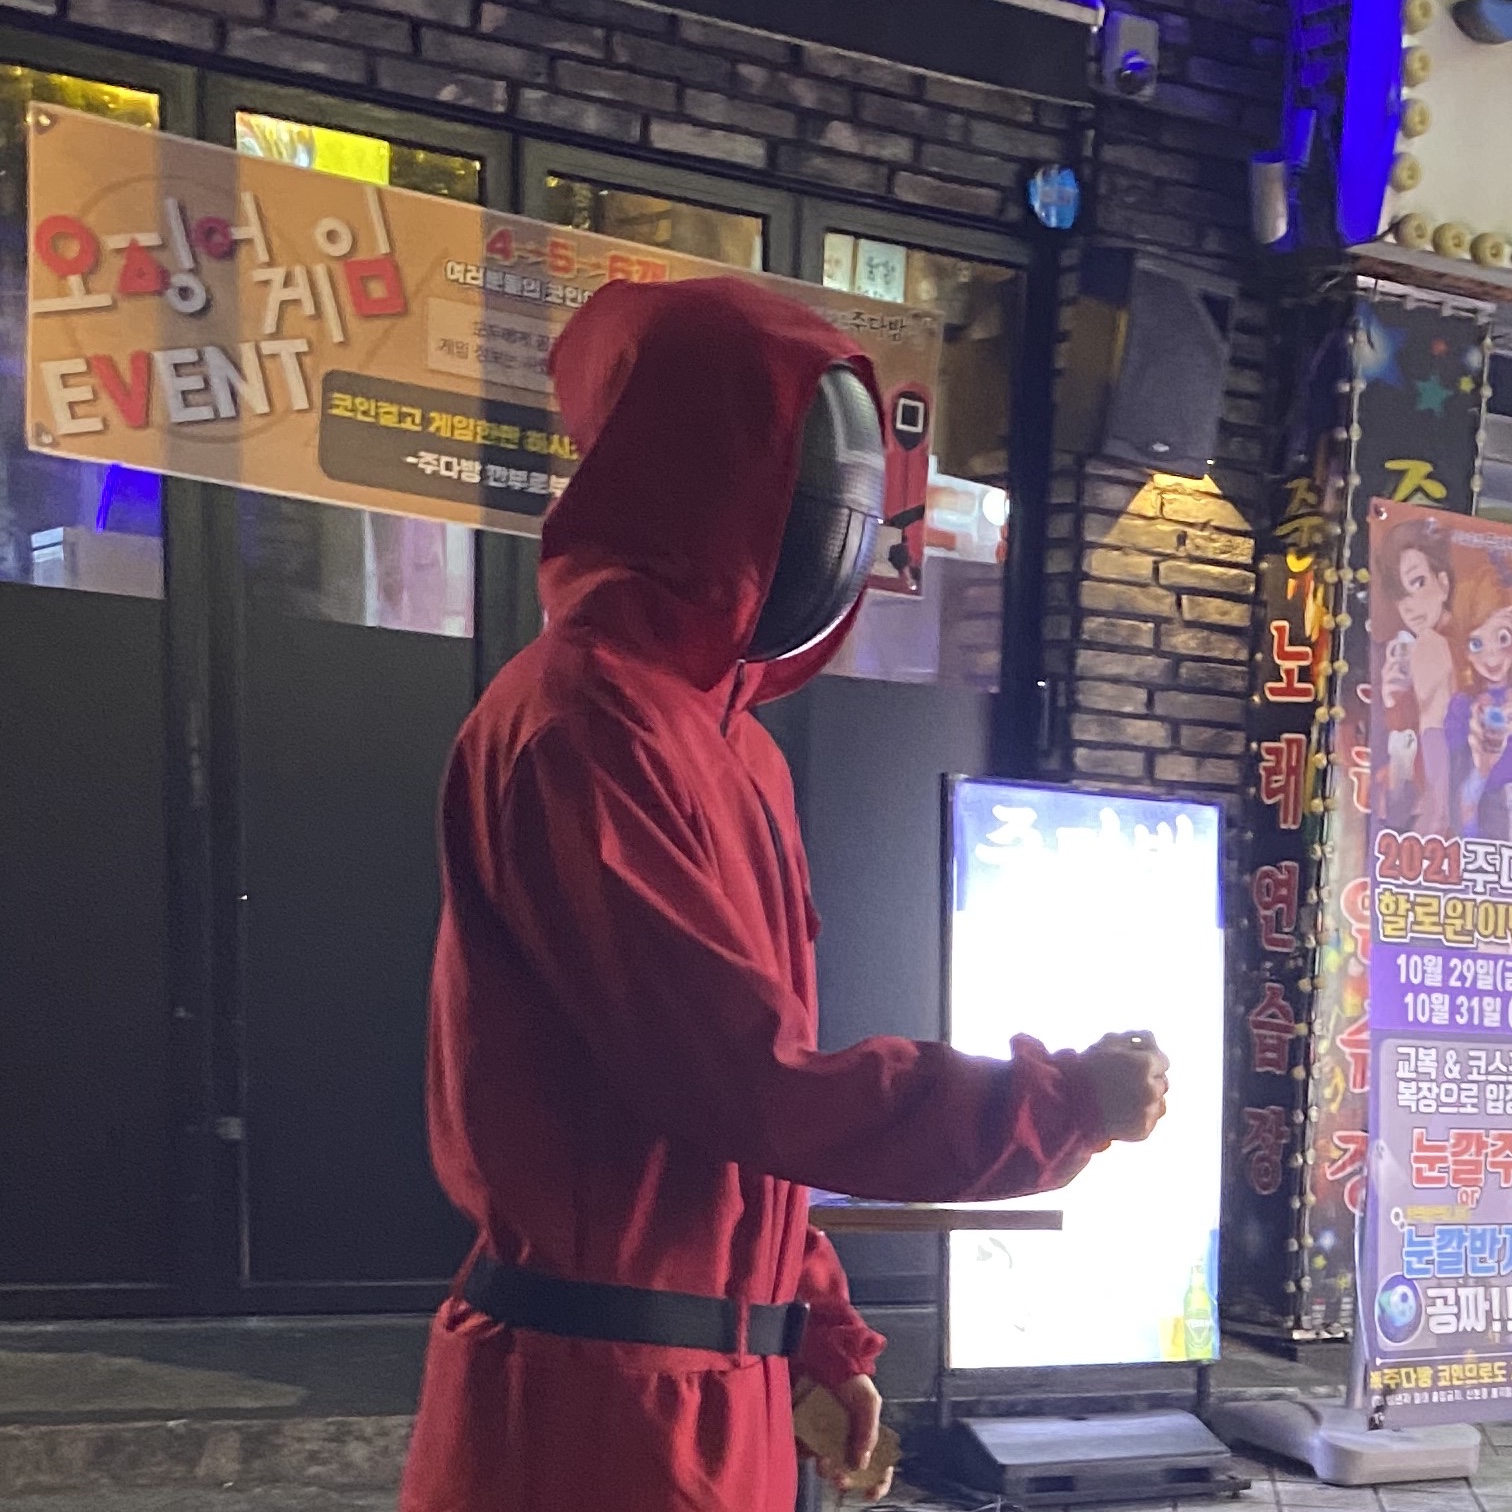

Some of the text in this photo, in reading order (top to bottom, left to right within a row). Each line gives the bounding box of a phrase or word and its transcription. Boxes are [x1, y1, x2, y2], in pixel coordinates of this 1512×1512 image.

[850, 310, 908, 342] 주다방
[39, 338, 312, 436] EVENT
[1396, 953, 1443, 988] 10월
[1403, 991, 1450, 1025] 10월
[1454, 995, 1503, 1028] 31일
[1396, 1047, 1438, 1080] 교복
[1443, 1050, 1462, 1080] &
[1397, 1080, 1480, 1114] 복장으로
